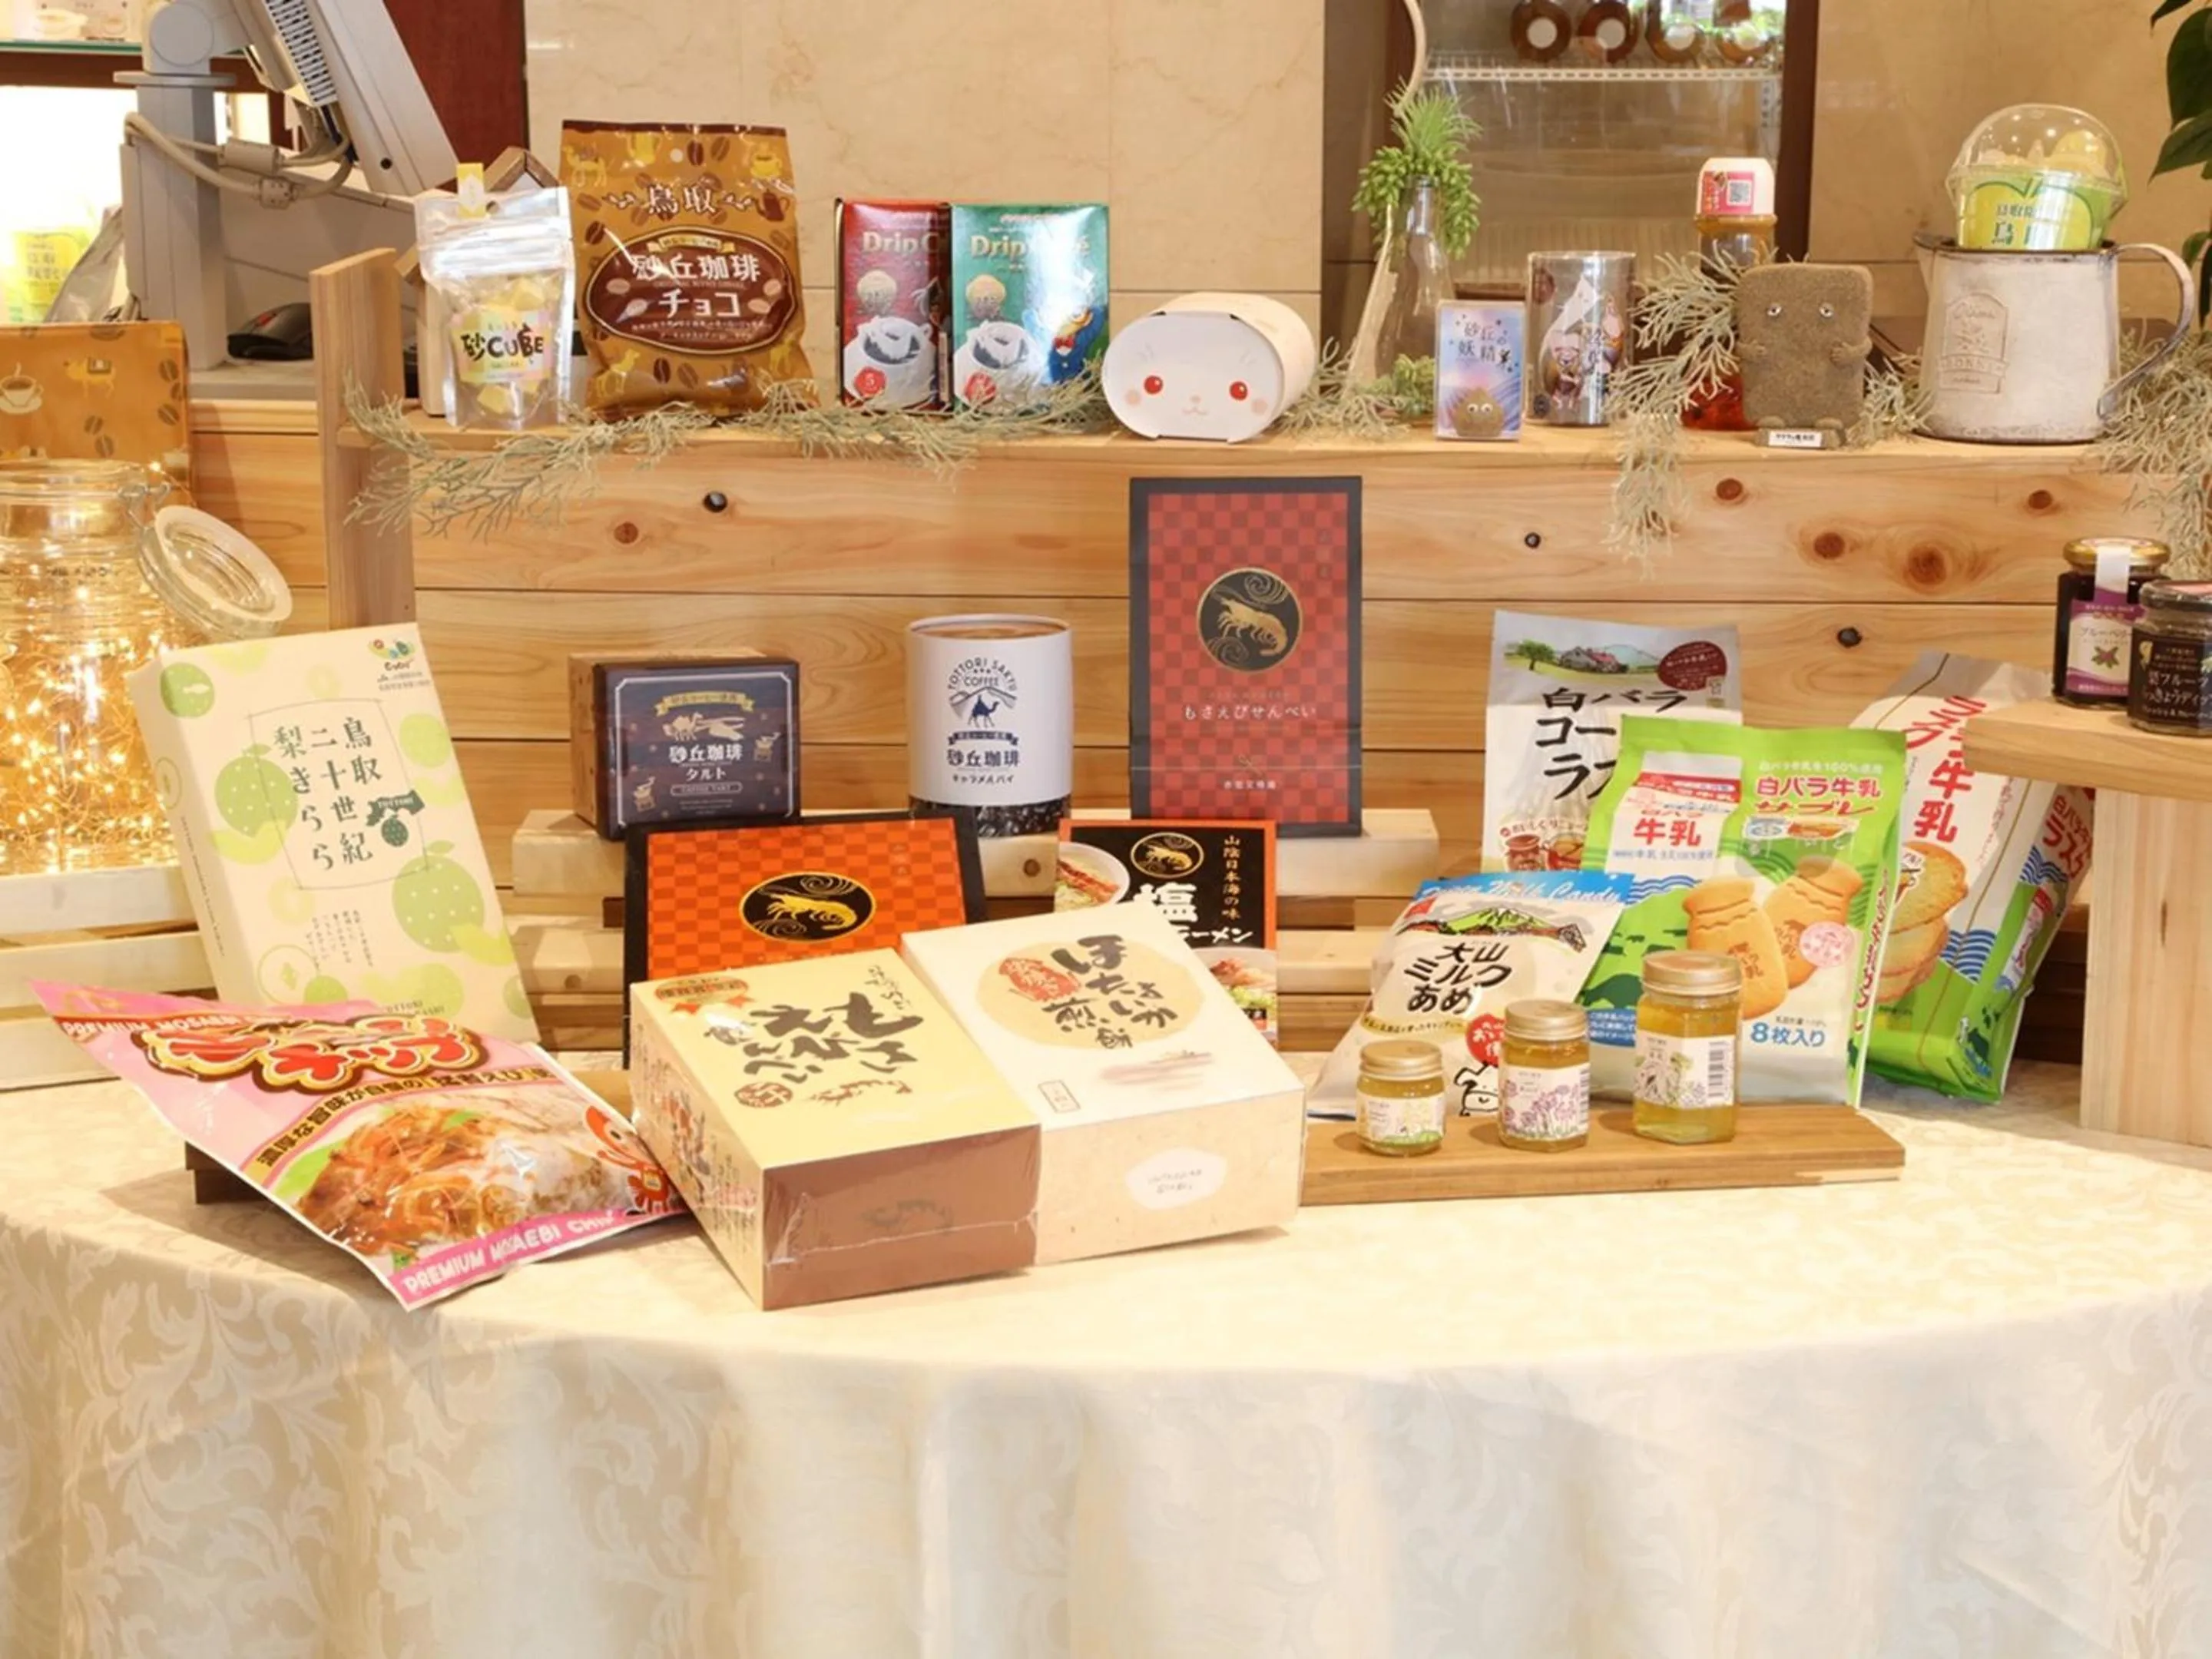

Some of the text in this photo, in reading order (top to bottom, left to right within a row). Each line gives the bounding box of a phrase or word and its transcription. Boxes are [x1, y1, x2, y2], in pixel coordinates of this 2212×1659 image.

[648, 184, 715, 214] 鳥取
[862, 231, 918, 256] Drip
[971, 234, 1027, 260] Drip
[658, 288, 740, 318] チョコ
[947, 657, 988, 690] TOTTORI
[964, 676, 999, 687] COFFEE
[1185, 704, 1316, 720] もさえびせんべい
[1542, 687, 1687, 713] 白バラ
[1536, 717, 1617, 747] コー
[343, 717, 383, 785] 鳥取
[686, 767, 727, 782] タルト
[1756, 776, 1882, 798] 白バラ牛乳
[273, 725, 334, 871] 梨きらら
[310, 727, 374, 865] 二十世紀
[1754, 800, 1876, 816] サブレ
[1912, 759, 1975, 843] 牛乳
[1633, 817, 1702, 848] 牛乳
[1221, 834, 1242, 922] 山陰日本海の味
[1434, 942, 1509, 963] 大山
[1403, 957, 1513, 987] ミルク
[1407, 984, 1473, 1015] あめ
[1750, 1022, 1826, 1048] 8枚入り
[402, 1249, 485, 1295] PREMIUM
